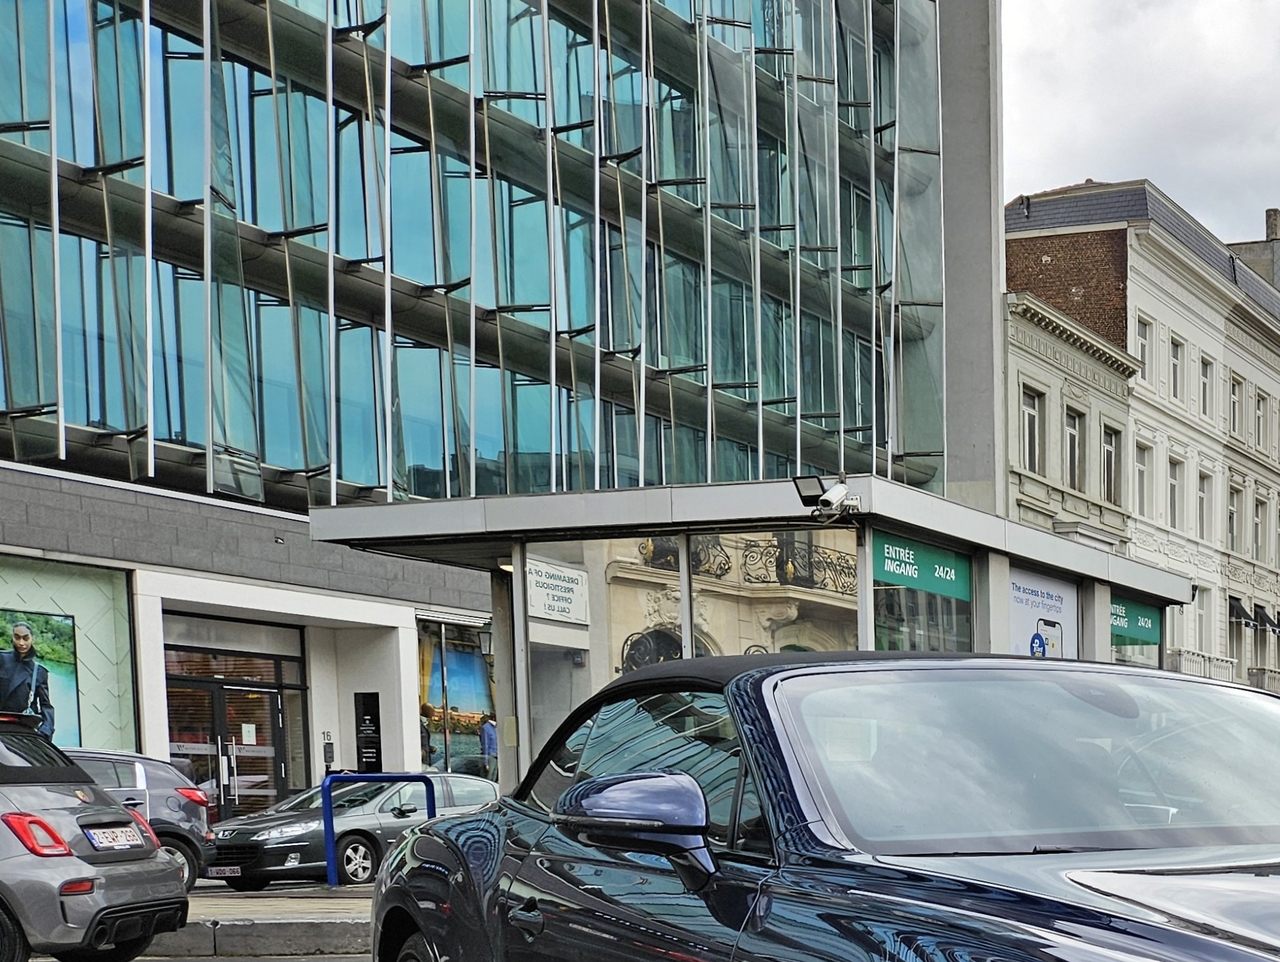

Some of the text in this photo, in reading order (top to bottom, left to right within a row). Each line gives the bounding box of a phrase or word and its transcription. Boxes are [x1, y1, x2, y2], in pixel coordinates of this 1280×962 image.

[884, 544, 915, 564] ENTRÉE
[884, 558, 956, 581] INGANG 24/24
[1011, 582, 1064, 605] The access to the city
[1013, 595, 1062, 614] now at your fingertips
[1137, 615, 1152, 629] 24/24
[321, 730, 332, 742] 16
